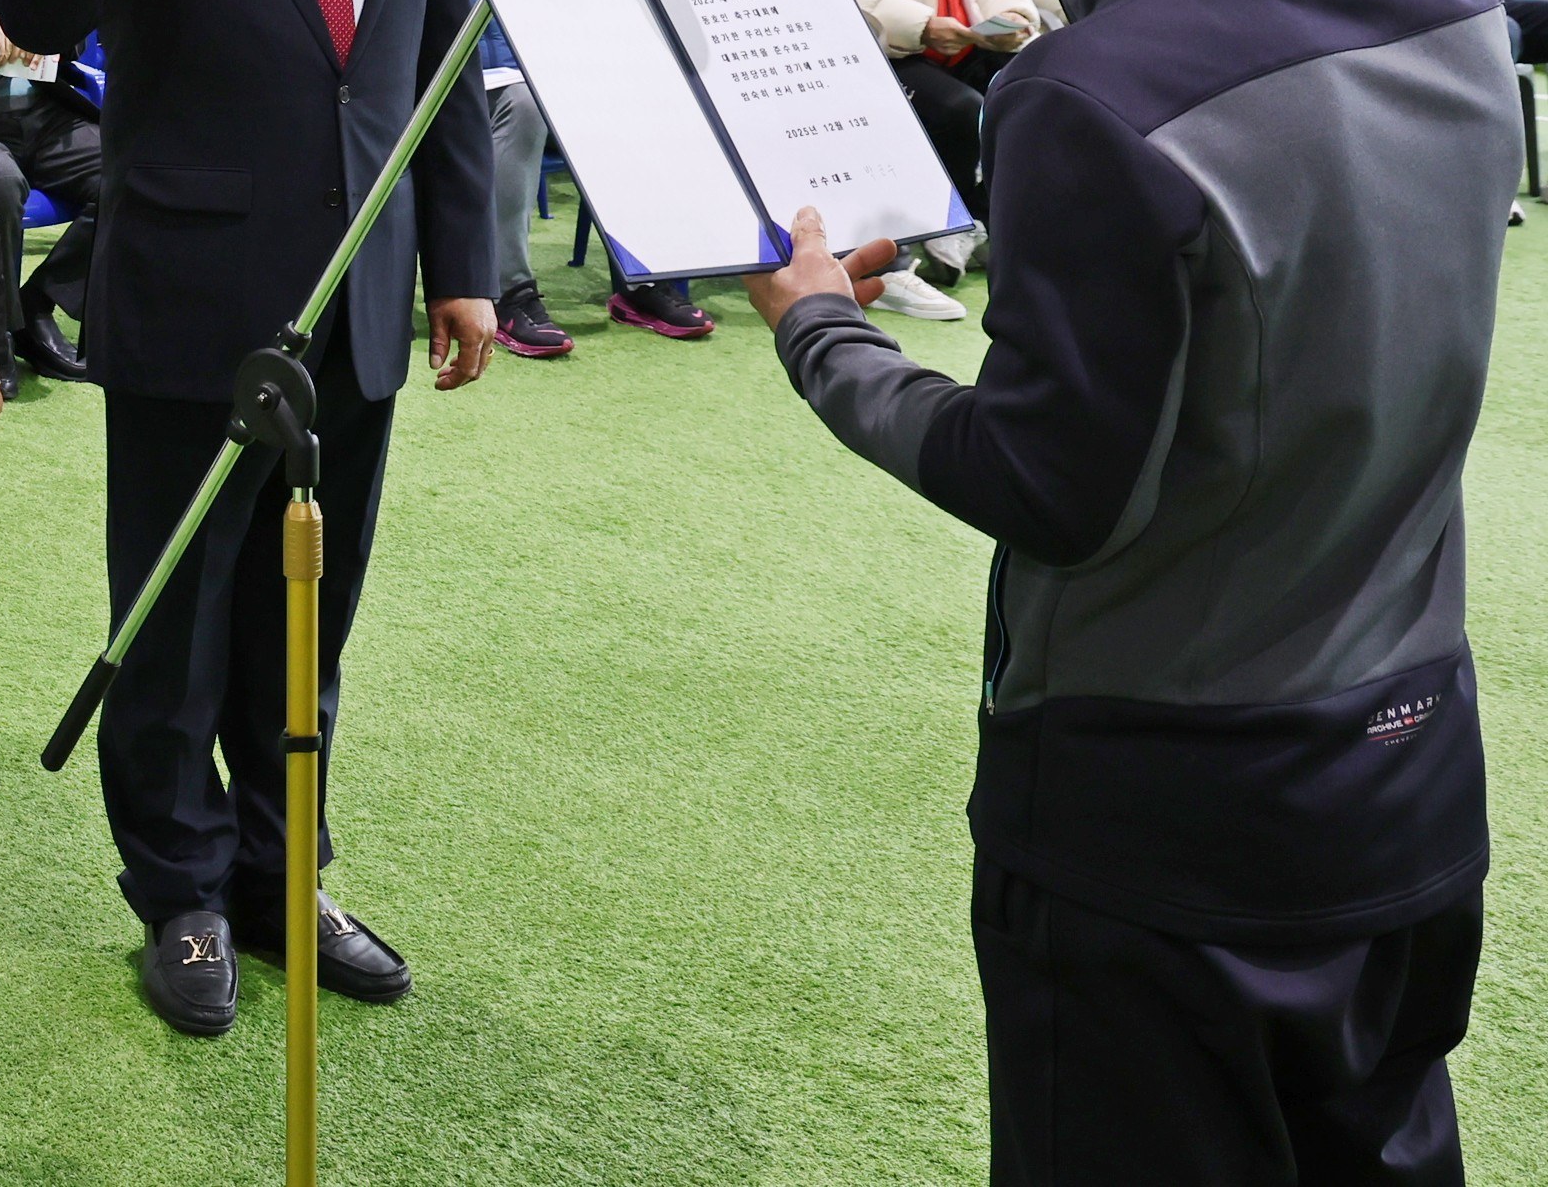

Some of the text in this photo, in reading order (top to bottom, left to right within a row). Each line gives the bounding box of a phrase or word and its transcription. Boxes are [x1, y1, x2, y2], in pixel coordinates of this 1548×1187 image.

[701, 5, 779, 25] 동호인 축구대회에
[711, 21, 813, 44] 참가한 우리선수 일동은
[721, 42, 810, 62] 대회규칙을 준수하고
[731, 54, 860, 82] 정정당당히 경기에 임할 것을
[740, 80, 830, 102] 엄숙히 선서 합니다.
[785, 116, 869, 138] 2025년 12월 13일
[809, 172, 852, 188] 선수대표
